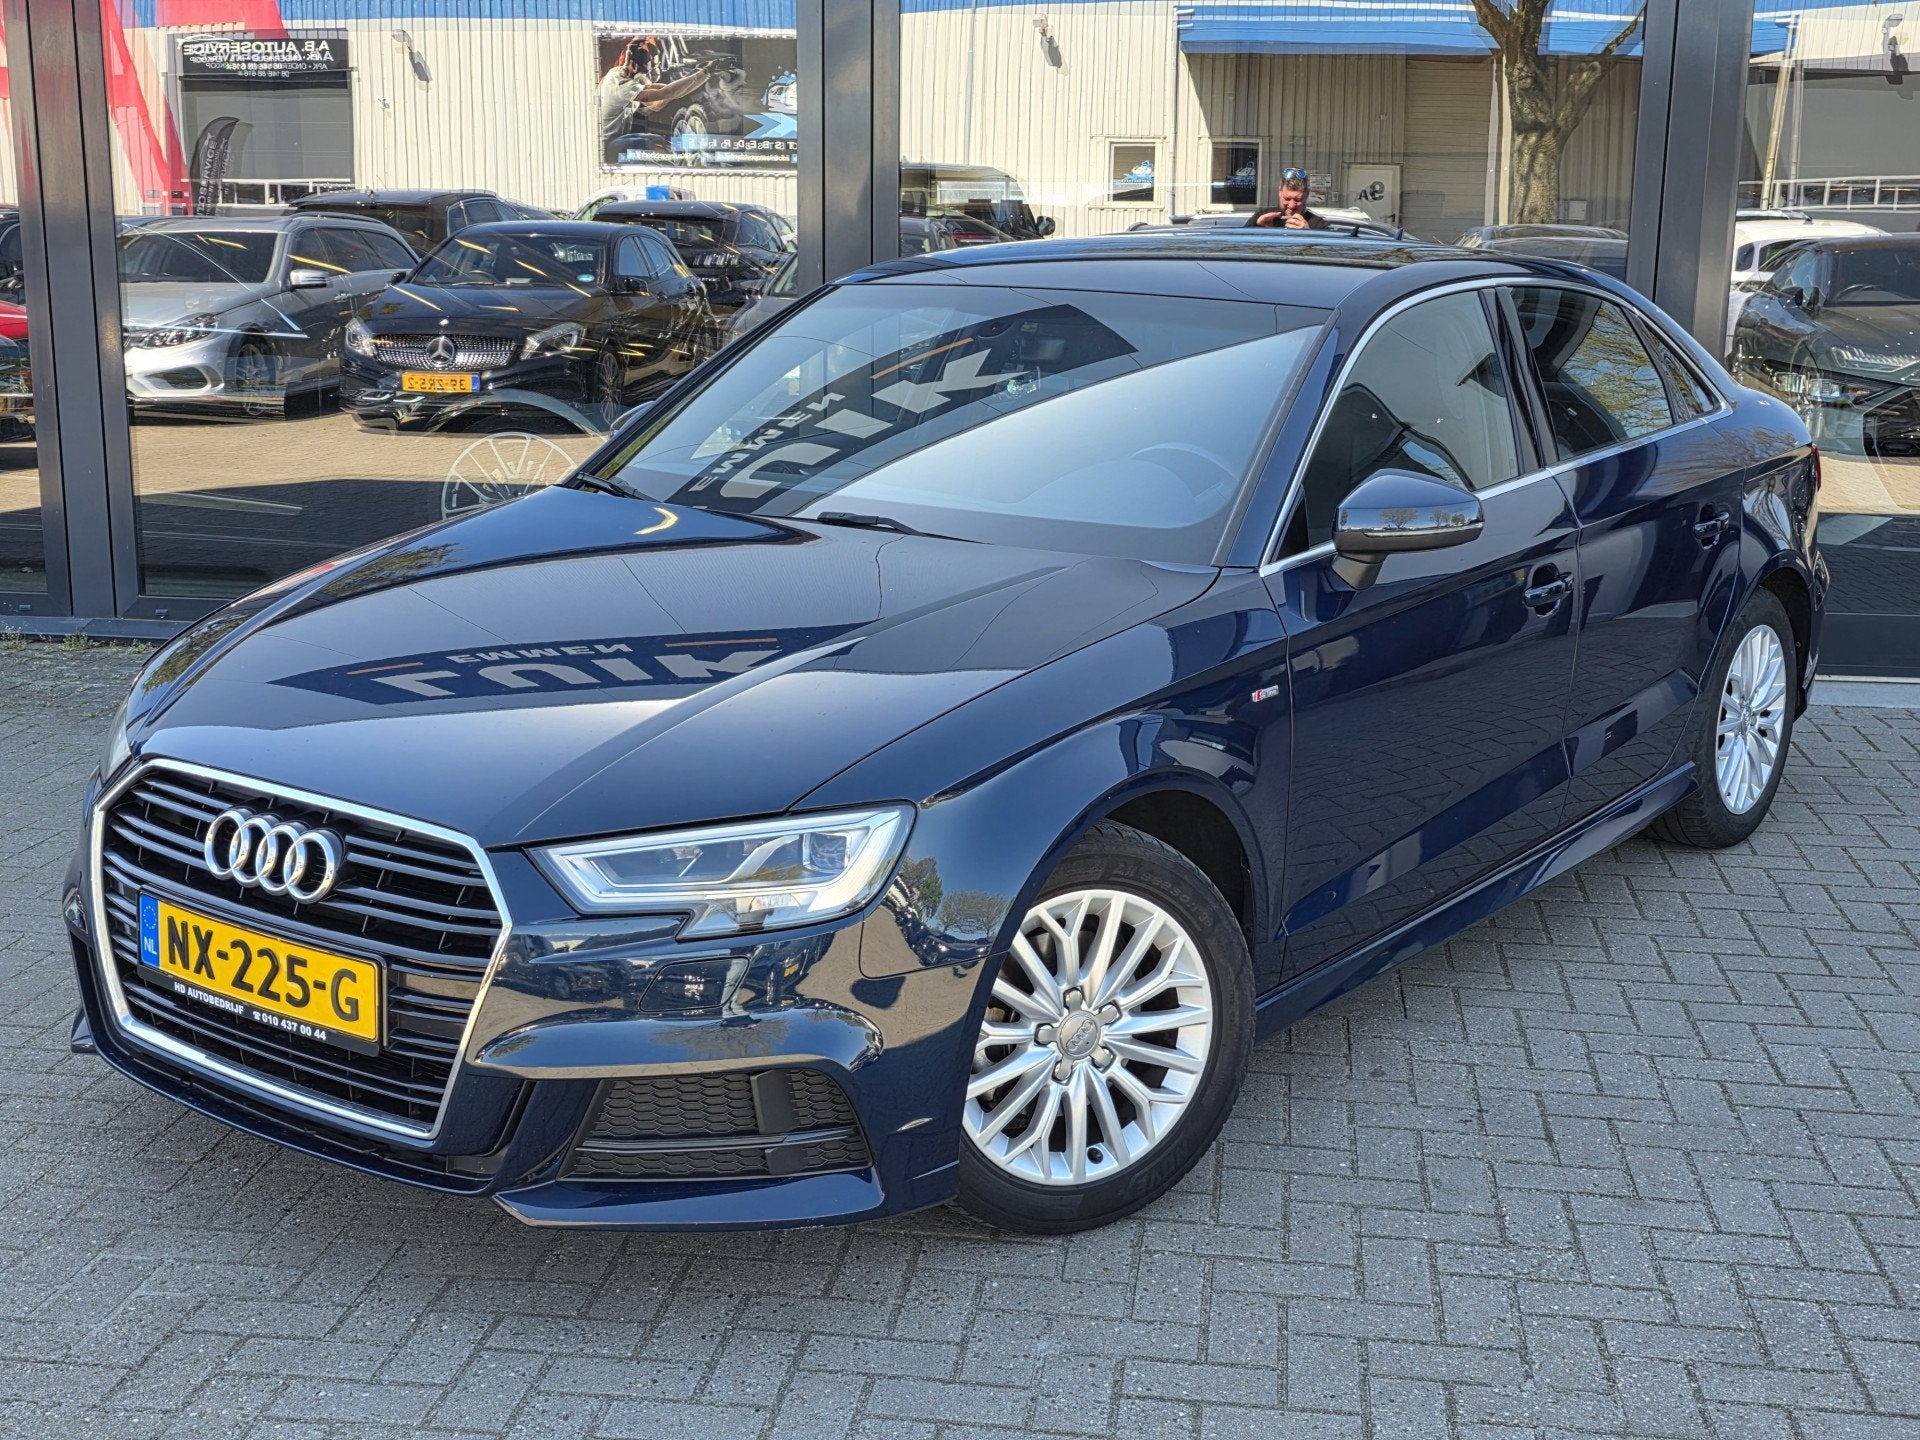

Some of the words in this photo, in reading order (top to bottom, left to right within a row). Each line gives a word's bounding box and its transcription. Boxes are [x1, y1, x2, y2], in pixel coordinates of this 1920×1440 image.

[143, 936, 158, 956] NL
[167, 915, 360, 1022] NX-225-G
[174, 981, 186, 994] HD
[187, 987, 244, 1015] AUTOBEDRIJF
[262, 1014, 279, 1027] 010
[280, 1020, 298, 1032] 437
[300, 1025, 312, 1037] 00
[314, 1029, 327, 1041] 44
